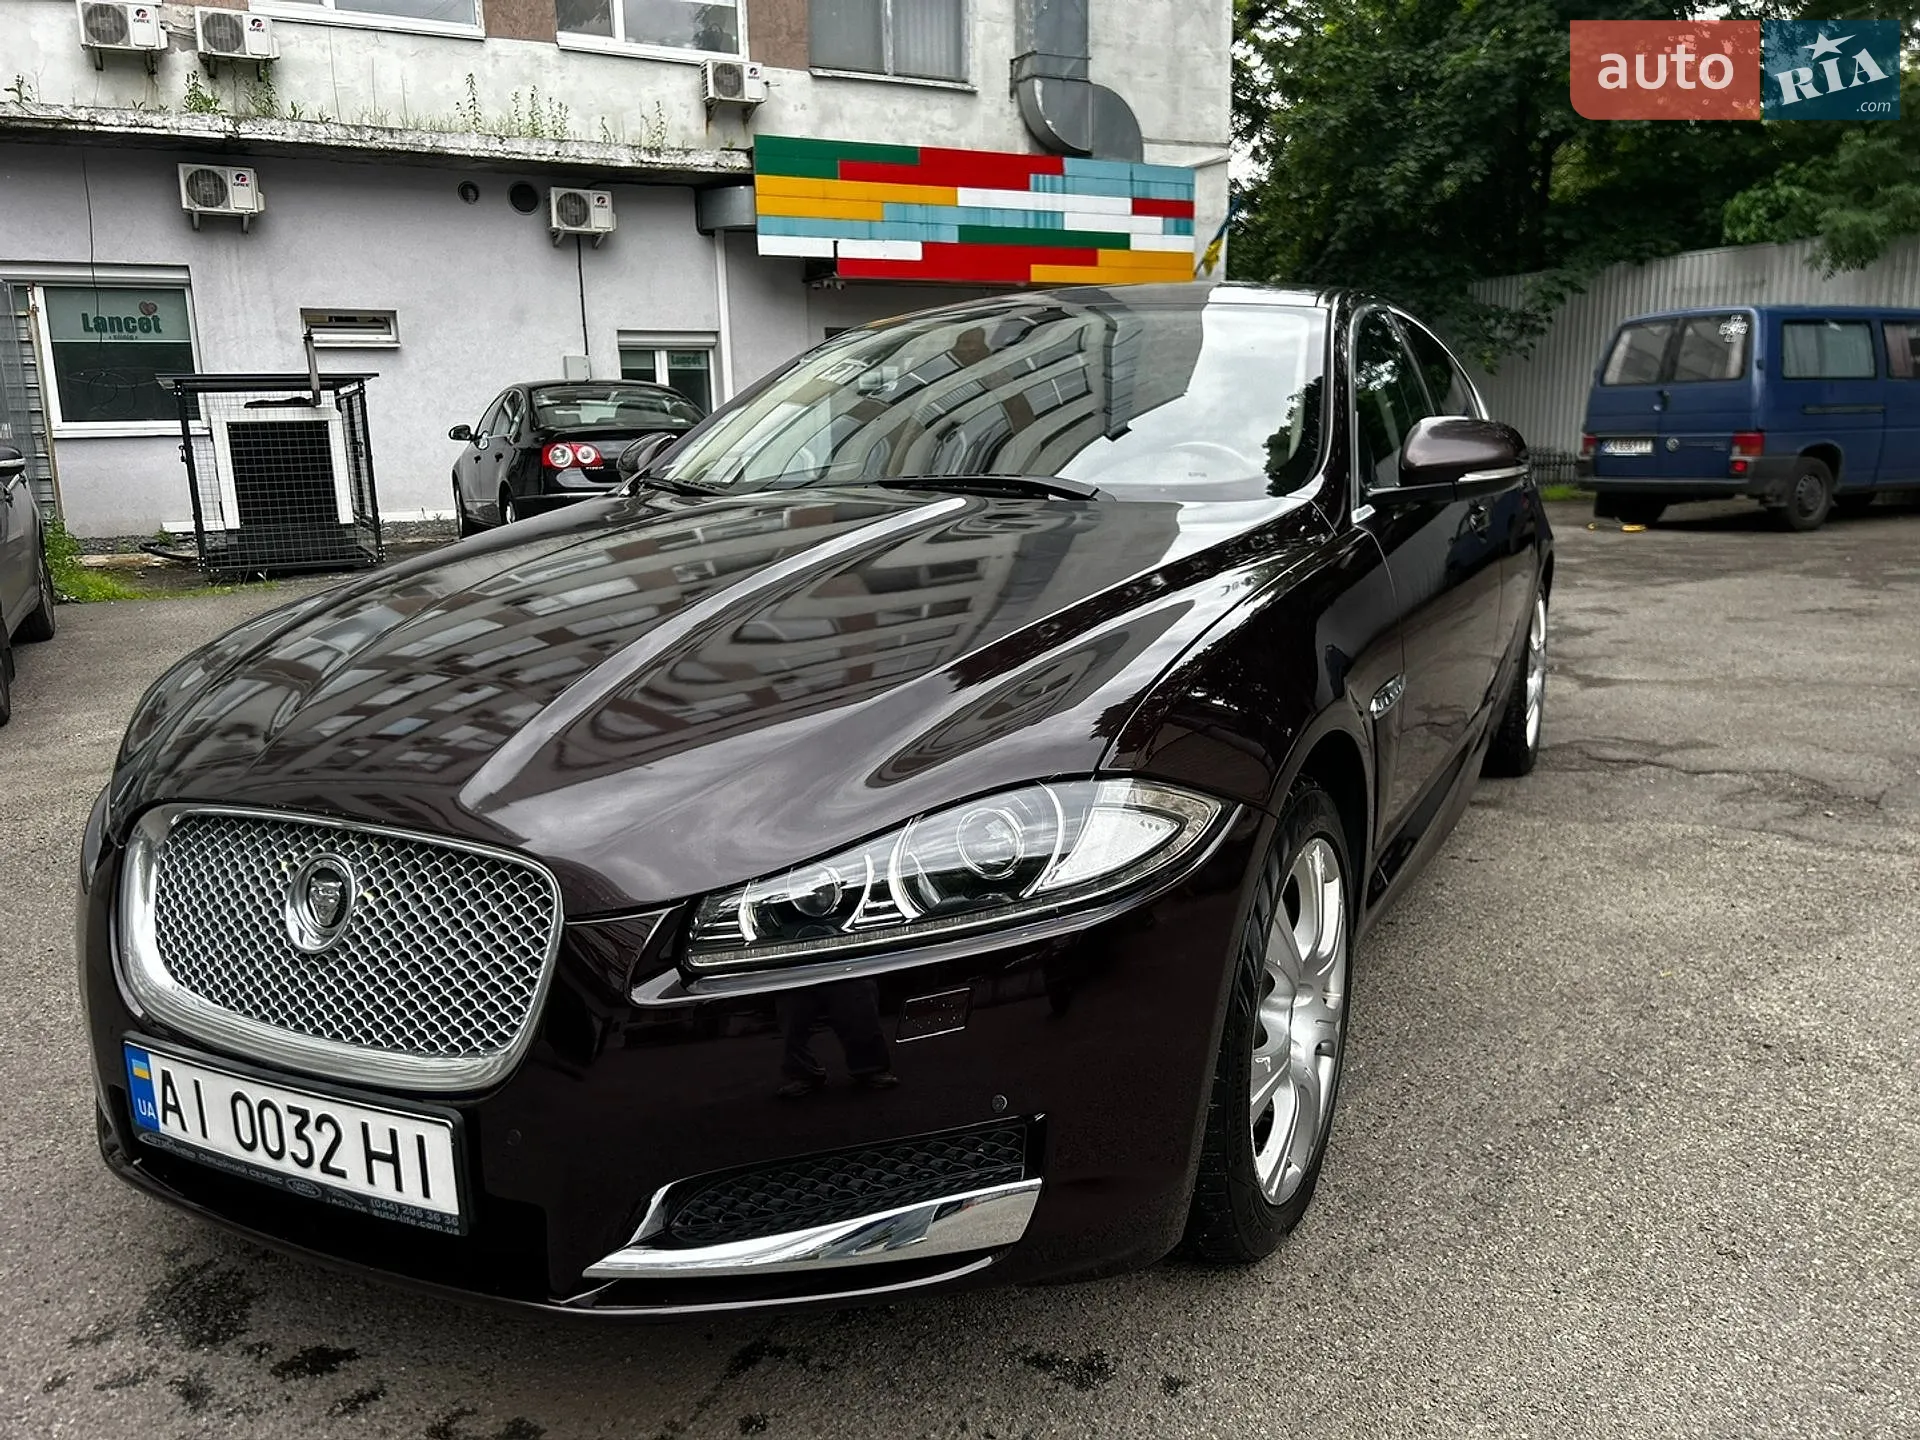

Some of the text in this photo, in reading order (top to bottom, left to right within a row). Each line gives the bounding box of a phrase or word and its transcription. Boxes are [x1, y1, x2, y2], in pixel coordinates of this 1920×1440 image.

[137, 1098, 157, 1120] UA
[161, 1068, 431, 1199] AI 0032 HI
[370, 1198, 399, 1213] (044)
[402, 1206, 424, 1219] 206
